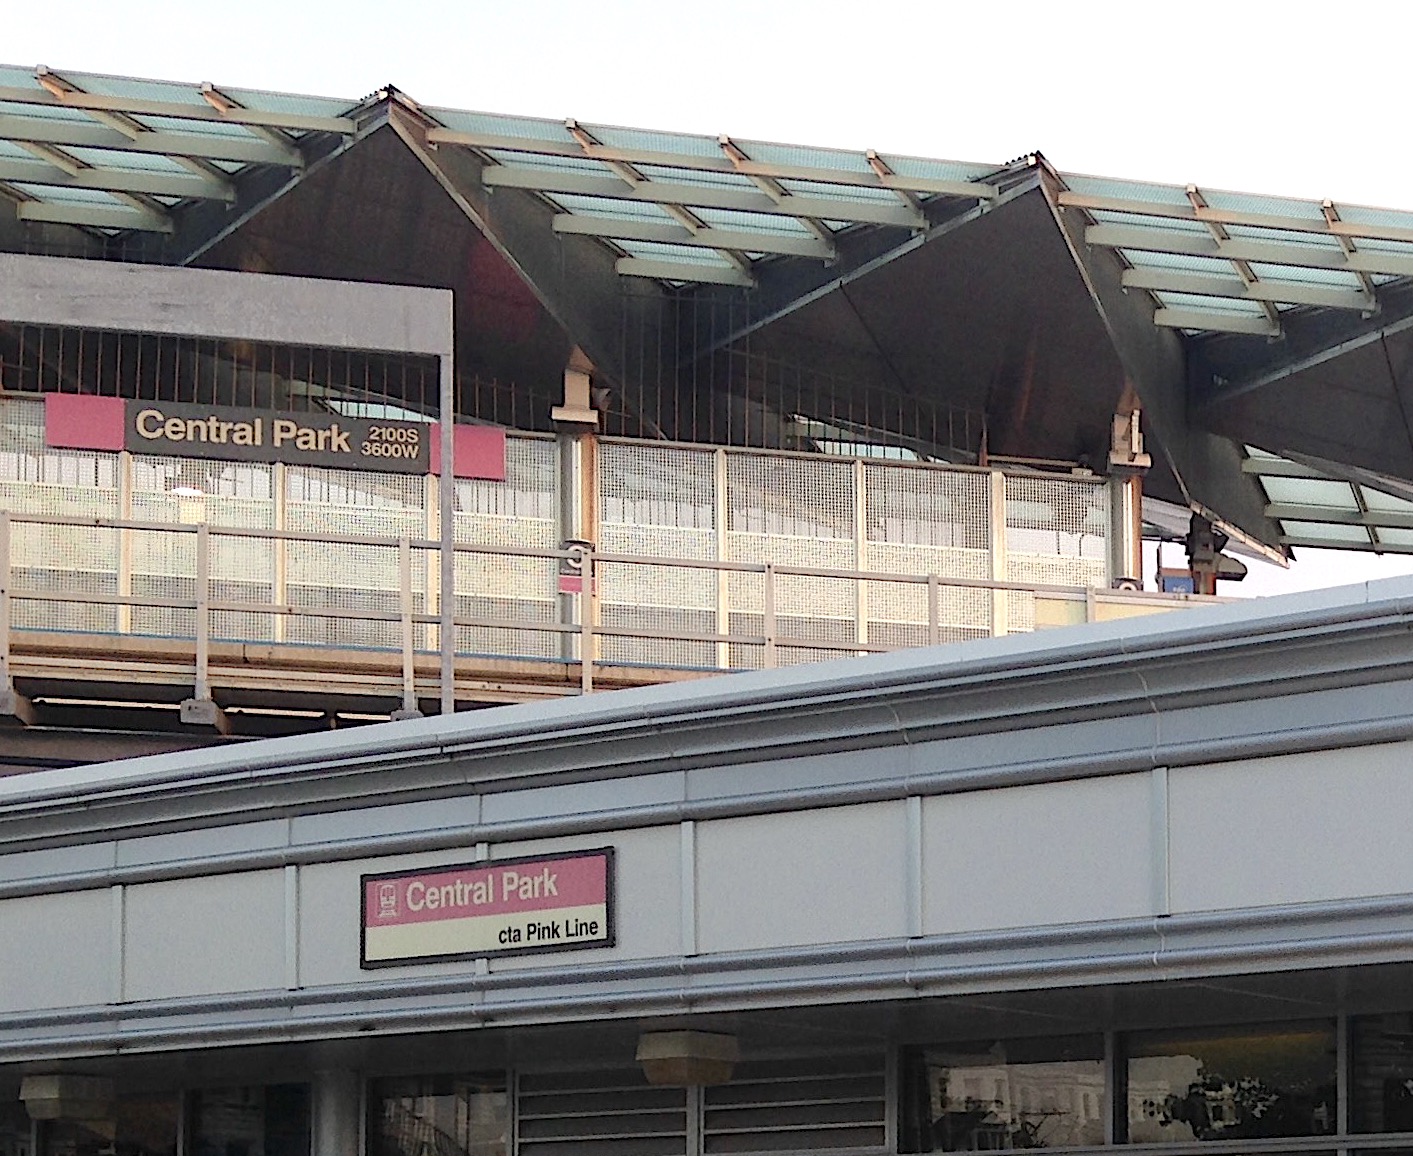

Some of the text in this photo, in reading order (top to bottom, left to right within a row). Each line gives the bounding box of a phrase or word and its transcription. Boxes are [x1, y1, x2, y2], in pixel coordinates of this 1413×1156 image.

[135, 409, 351, 453] Central Park
[368, 426, 419, 443] 2100S
[361, 441, 419, 459] 3600W
[406, 867, 558, 912] Central Park
[499, 918, 599, 944] cta Pink Line
